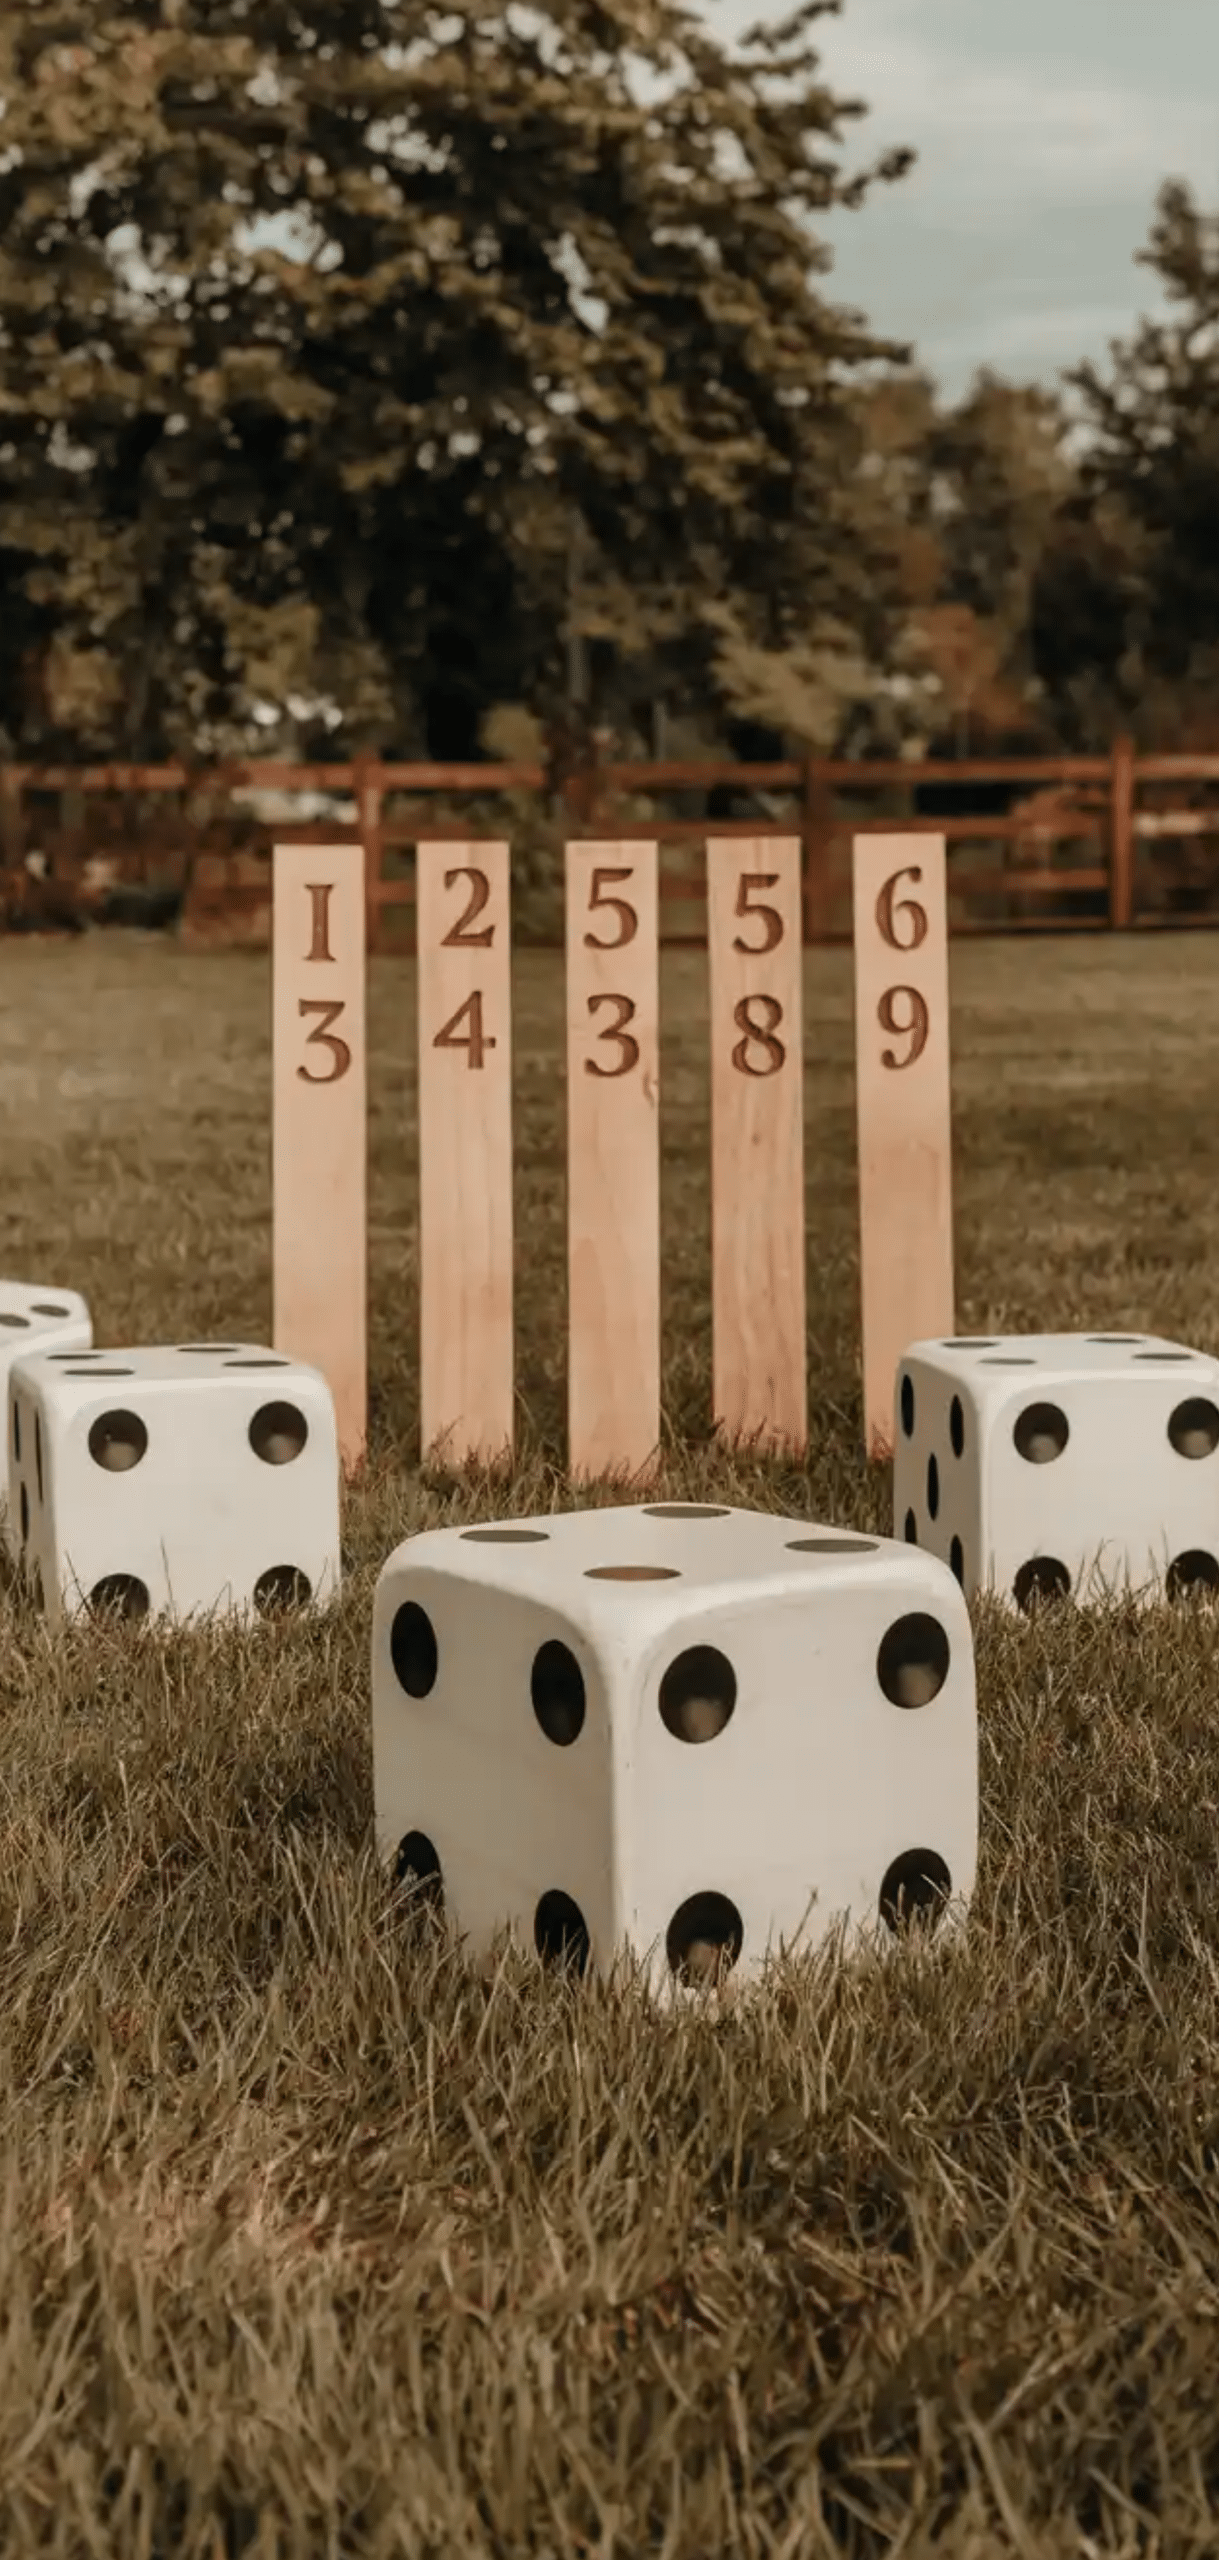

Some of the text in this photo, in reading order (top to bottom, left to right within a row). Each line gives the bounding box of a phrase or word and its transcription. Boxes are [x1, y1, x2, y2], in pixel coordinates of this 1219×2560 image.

[440, 867, 497, 948] 2
[583, 868, 640, 950] 5
[732, 872, 785, 956] 5
[875, 866, 930, 952] 6
[296, 998, 352, 1085] 3
[432, 990, 497, 1070] 4
[583, 993, 641, 1078] 3
[731, 994, 787, 1077] 8
[877, 985, 930, 1071] 9
